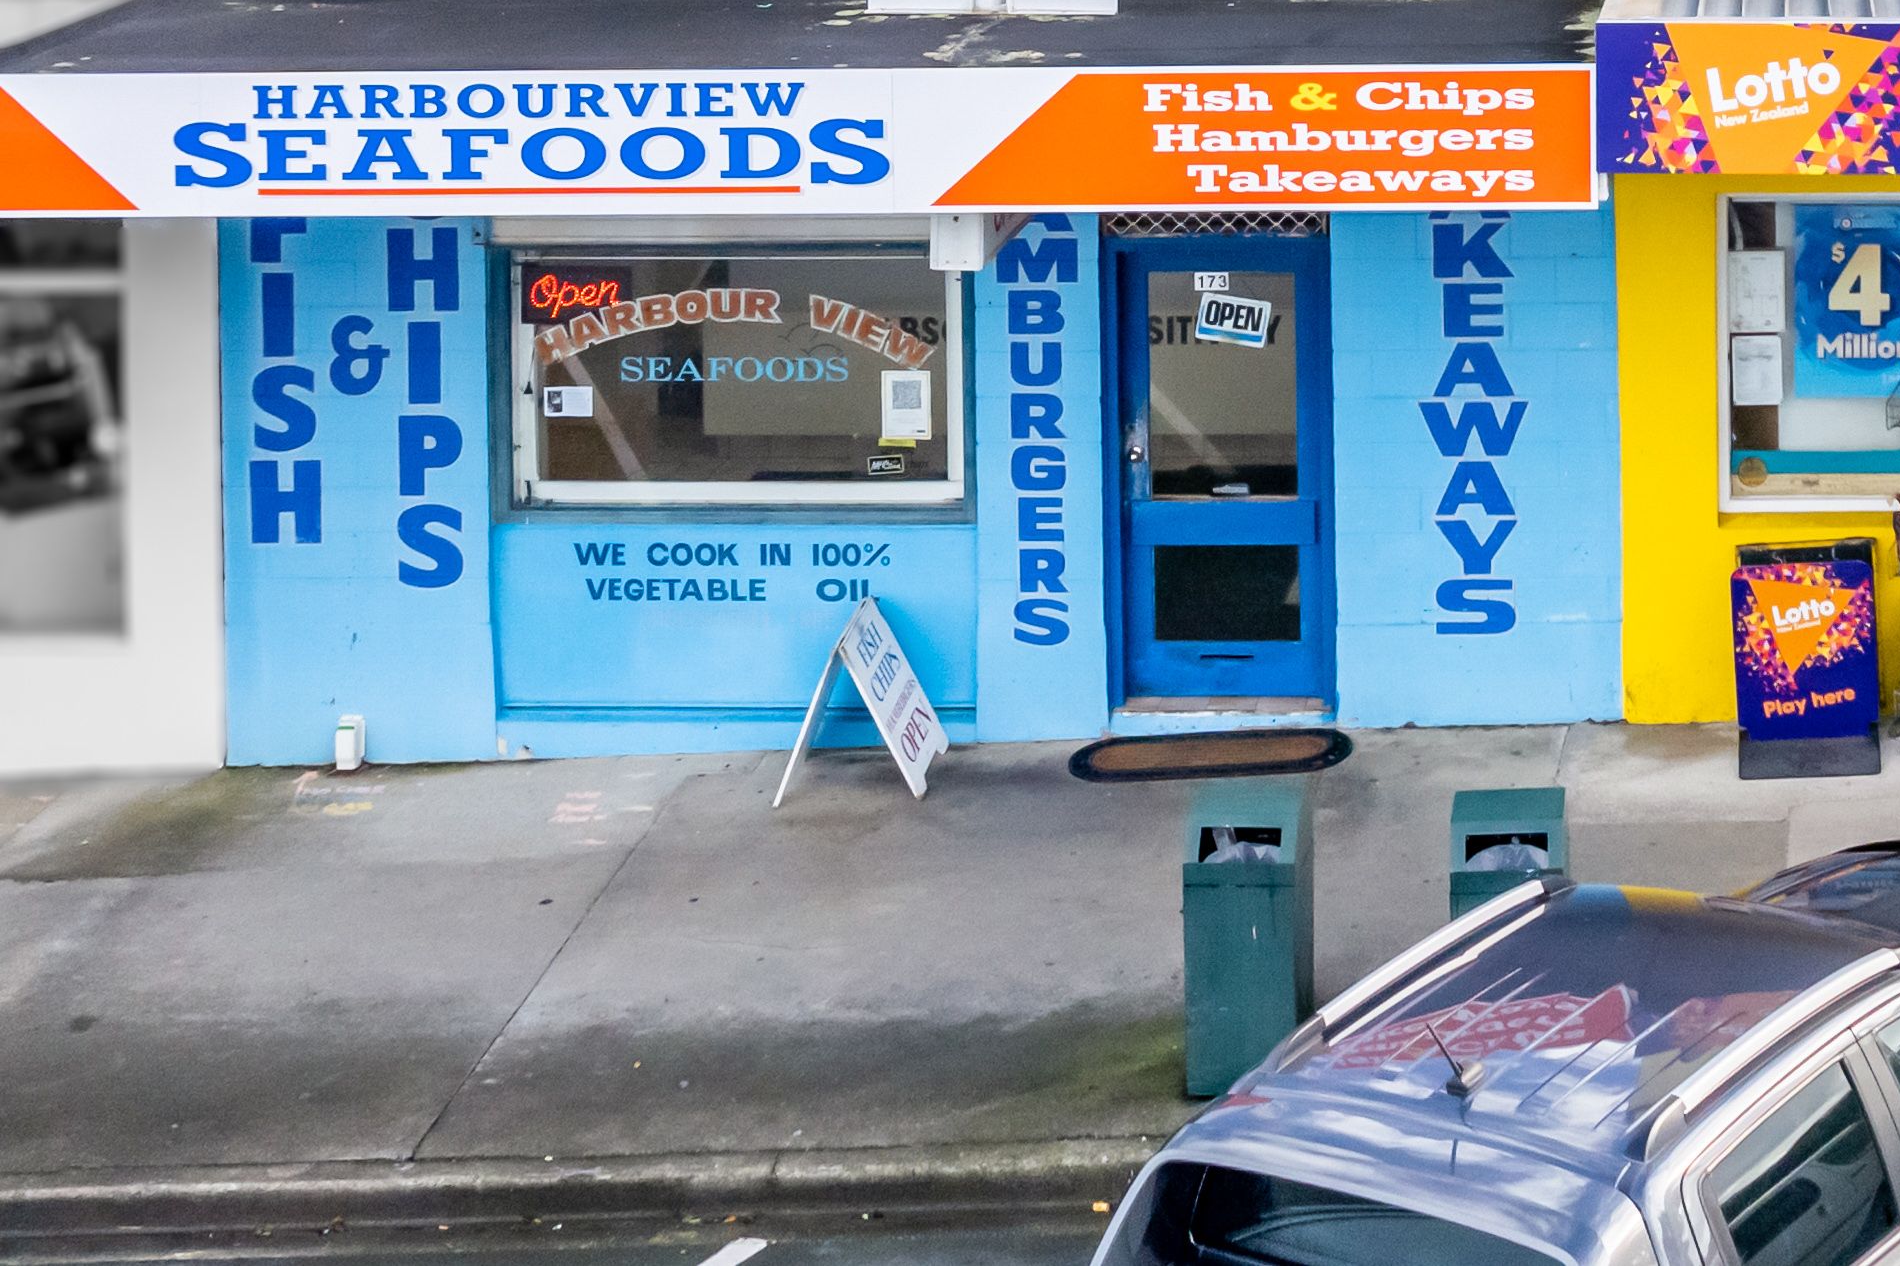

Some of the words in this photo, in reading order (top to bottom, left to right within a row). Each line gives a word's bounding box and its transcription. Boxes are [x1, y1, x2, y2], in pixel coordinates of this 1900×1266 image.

[252, 81, 805, 120] HARBOURVIEW
[1142, 82, 1272, 113] Fish
[1289, 81, 1338, 112] &
[1355, 80, 1536, 116] Chips
[1706, 56, 1841, 112] Lotto
[1714, 112, 1748, 129] New
[1750, 100, 1810, 126] Zealand
[173, 118, 891, 188] SEAFOODS
[1152, 123, 1535, 157] Hamburgers
[1186, 164, 1535, 197] Takeaways
[529, 273, 620, 319] Open
[1198, 275, 1228, 289] 173
[533, 288, 783, 367] HARBOUR
[808, 294, 937, 370] VIEW
[1204, 299, 1264, 332] OPEN
[329, 314, 391, 396] &
[620, 356, 850, 384] SEAFOODS
[386, 217, 464, 588] HIPS
[574, 543, 626, 566] WE
[646, 543, 739, 566] COOK
[759, 543, 792, 566] IN
[811, 543, 892, 567] 100%
[585, 577, 767, 601] VEGETABLE
[1771, 598, 1836, 627] Lotto
[857, 621, 883, 667] FISH
[871, 649, 899, 701] CHIPS
[1762, 698, 1807, 719] Play
[1810, 687, 1857, 709] here
[901, 704, 931, 762] OPEN
